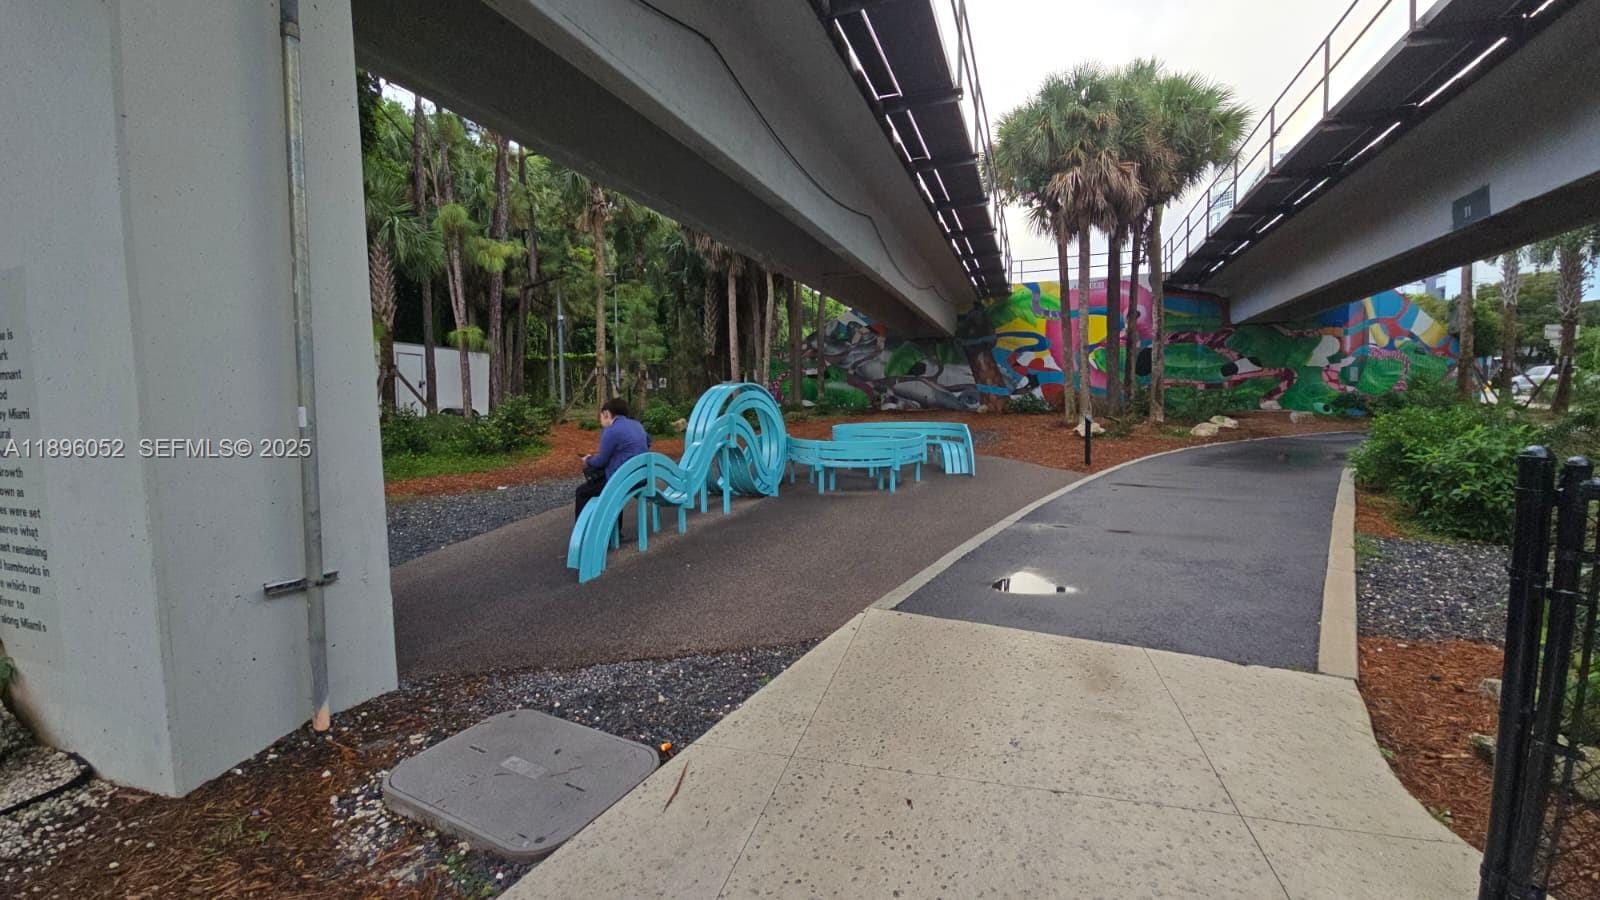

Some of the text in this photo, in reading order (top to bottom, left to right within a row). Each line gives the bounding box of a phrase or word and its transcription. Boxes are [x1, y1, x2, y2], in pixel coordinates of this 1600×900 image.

[7, 328, 13, 340] is
[8, 408, 30, 419] Miami
[16, 489, 24, 497] as
[9, 508, 28, 517] were
[29, 508, 41, 518] set
[20, 525, 39, 538] what
[12, 545, 48, 560] remaining
[3, 560, 41, 576] hammocks
[42, 565, 50, 577] in
[6, 580, 28, 592] which
[28, 585, 41, 595] ran
[16, 600, 25, 610] to
